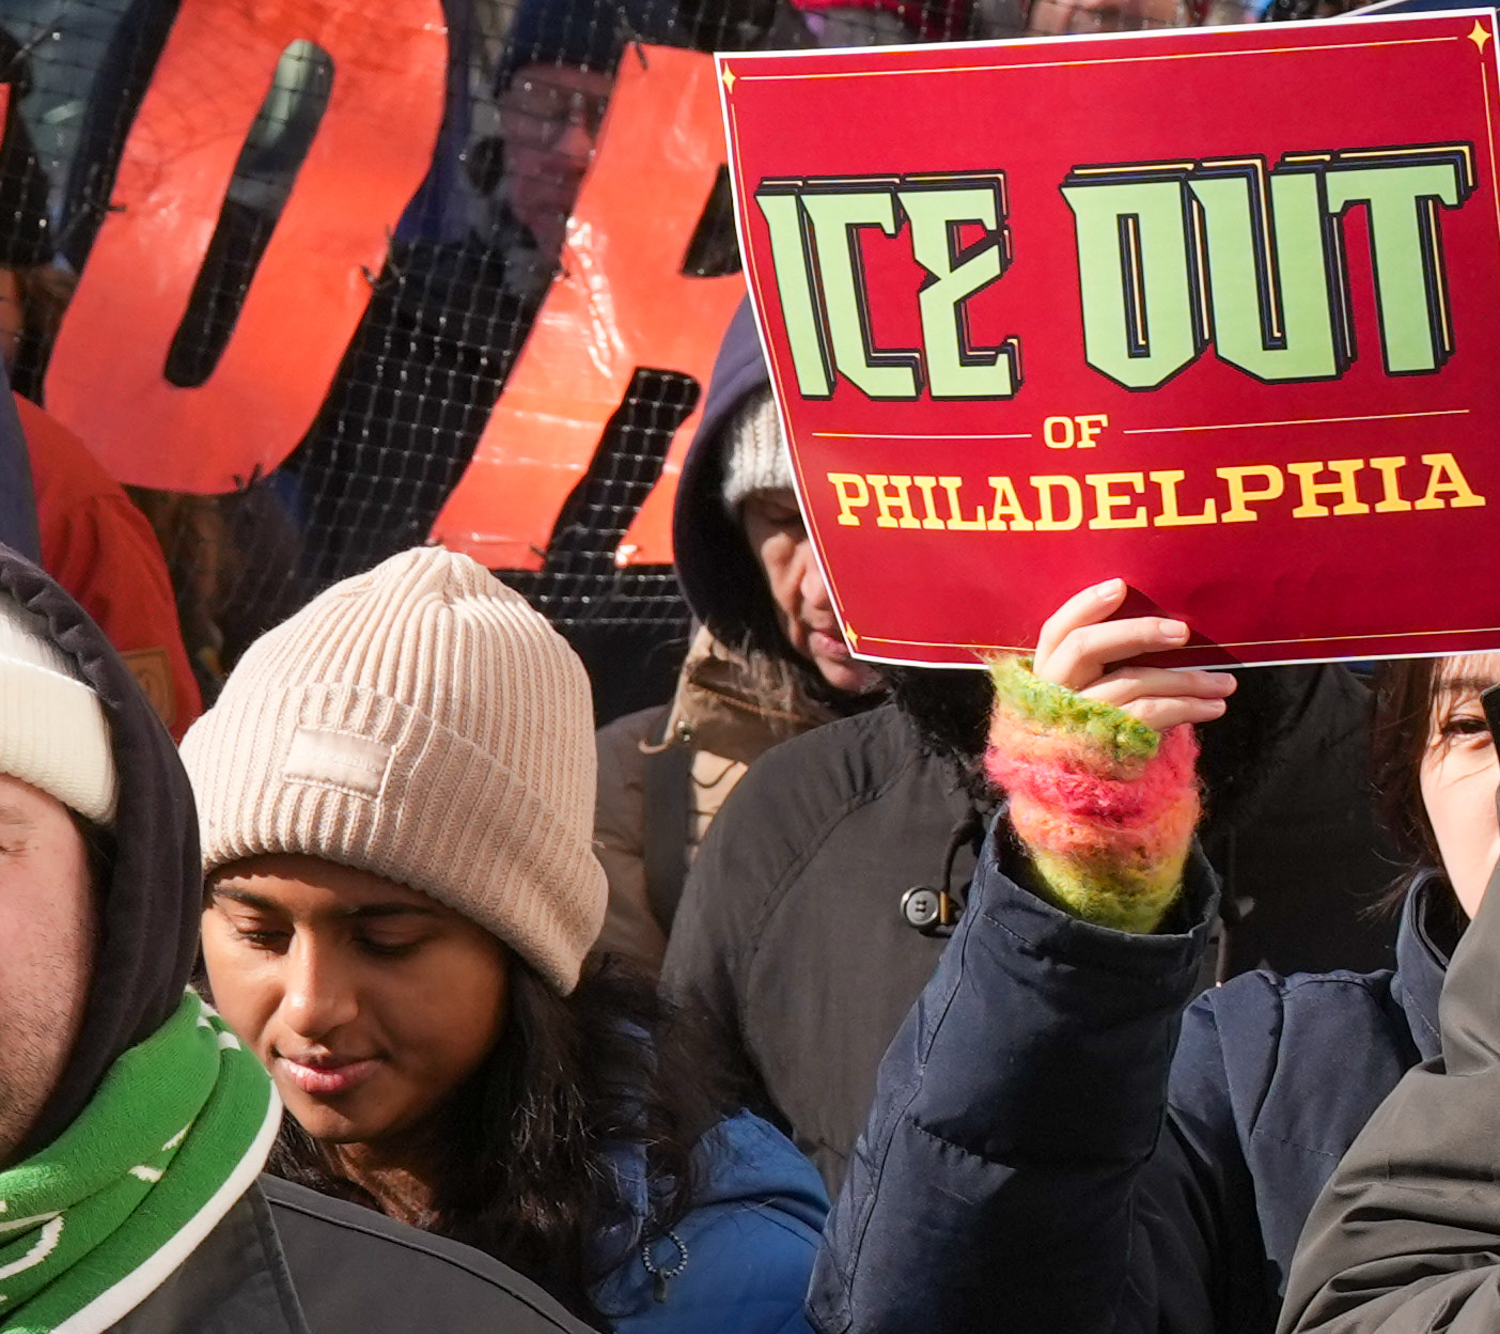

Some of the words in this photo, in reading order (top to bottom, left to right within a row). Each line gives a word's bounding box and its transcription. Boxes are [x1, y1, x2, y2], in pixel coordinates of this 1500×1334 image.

[757, 170, 1020, 400] ICE
[1063, 143, 1474, 391] OUT
[1043, 414, 1110, 450] OF
[827, 453, 1486, 531] PHILADELPHIA
